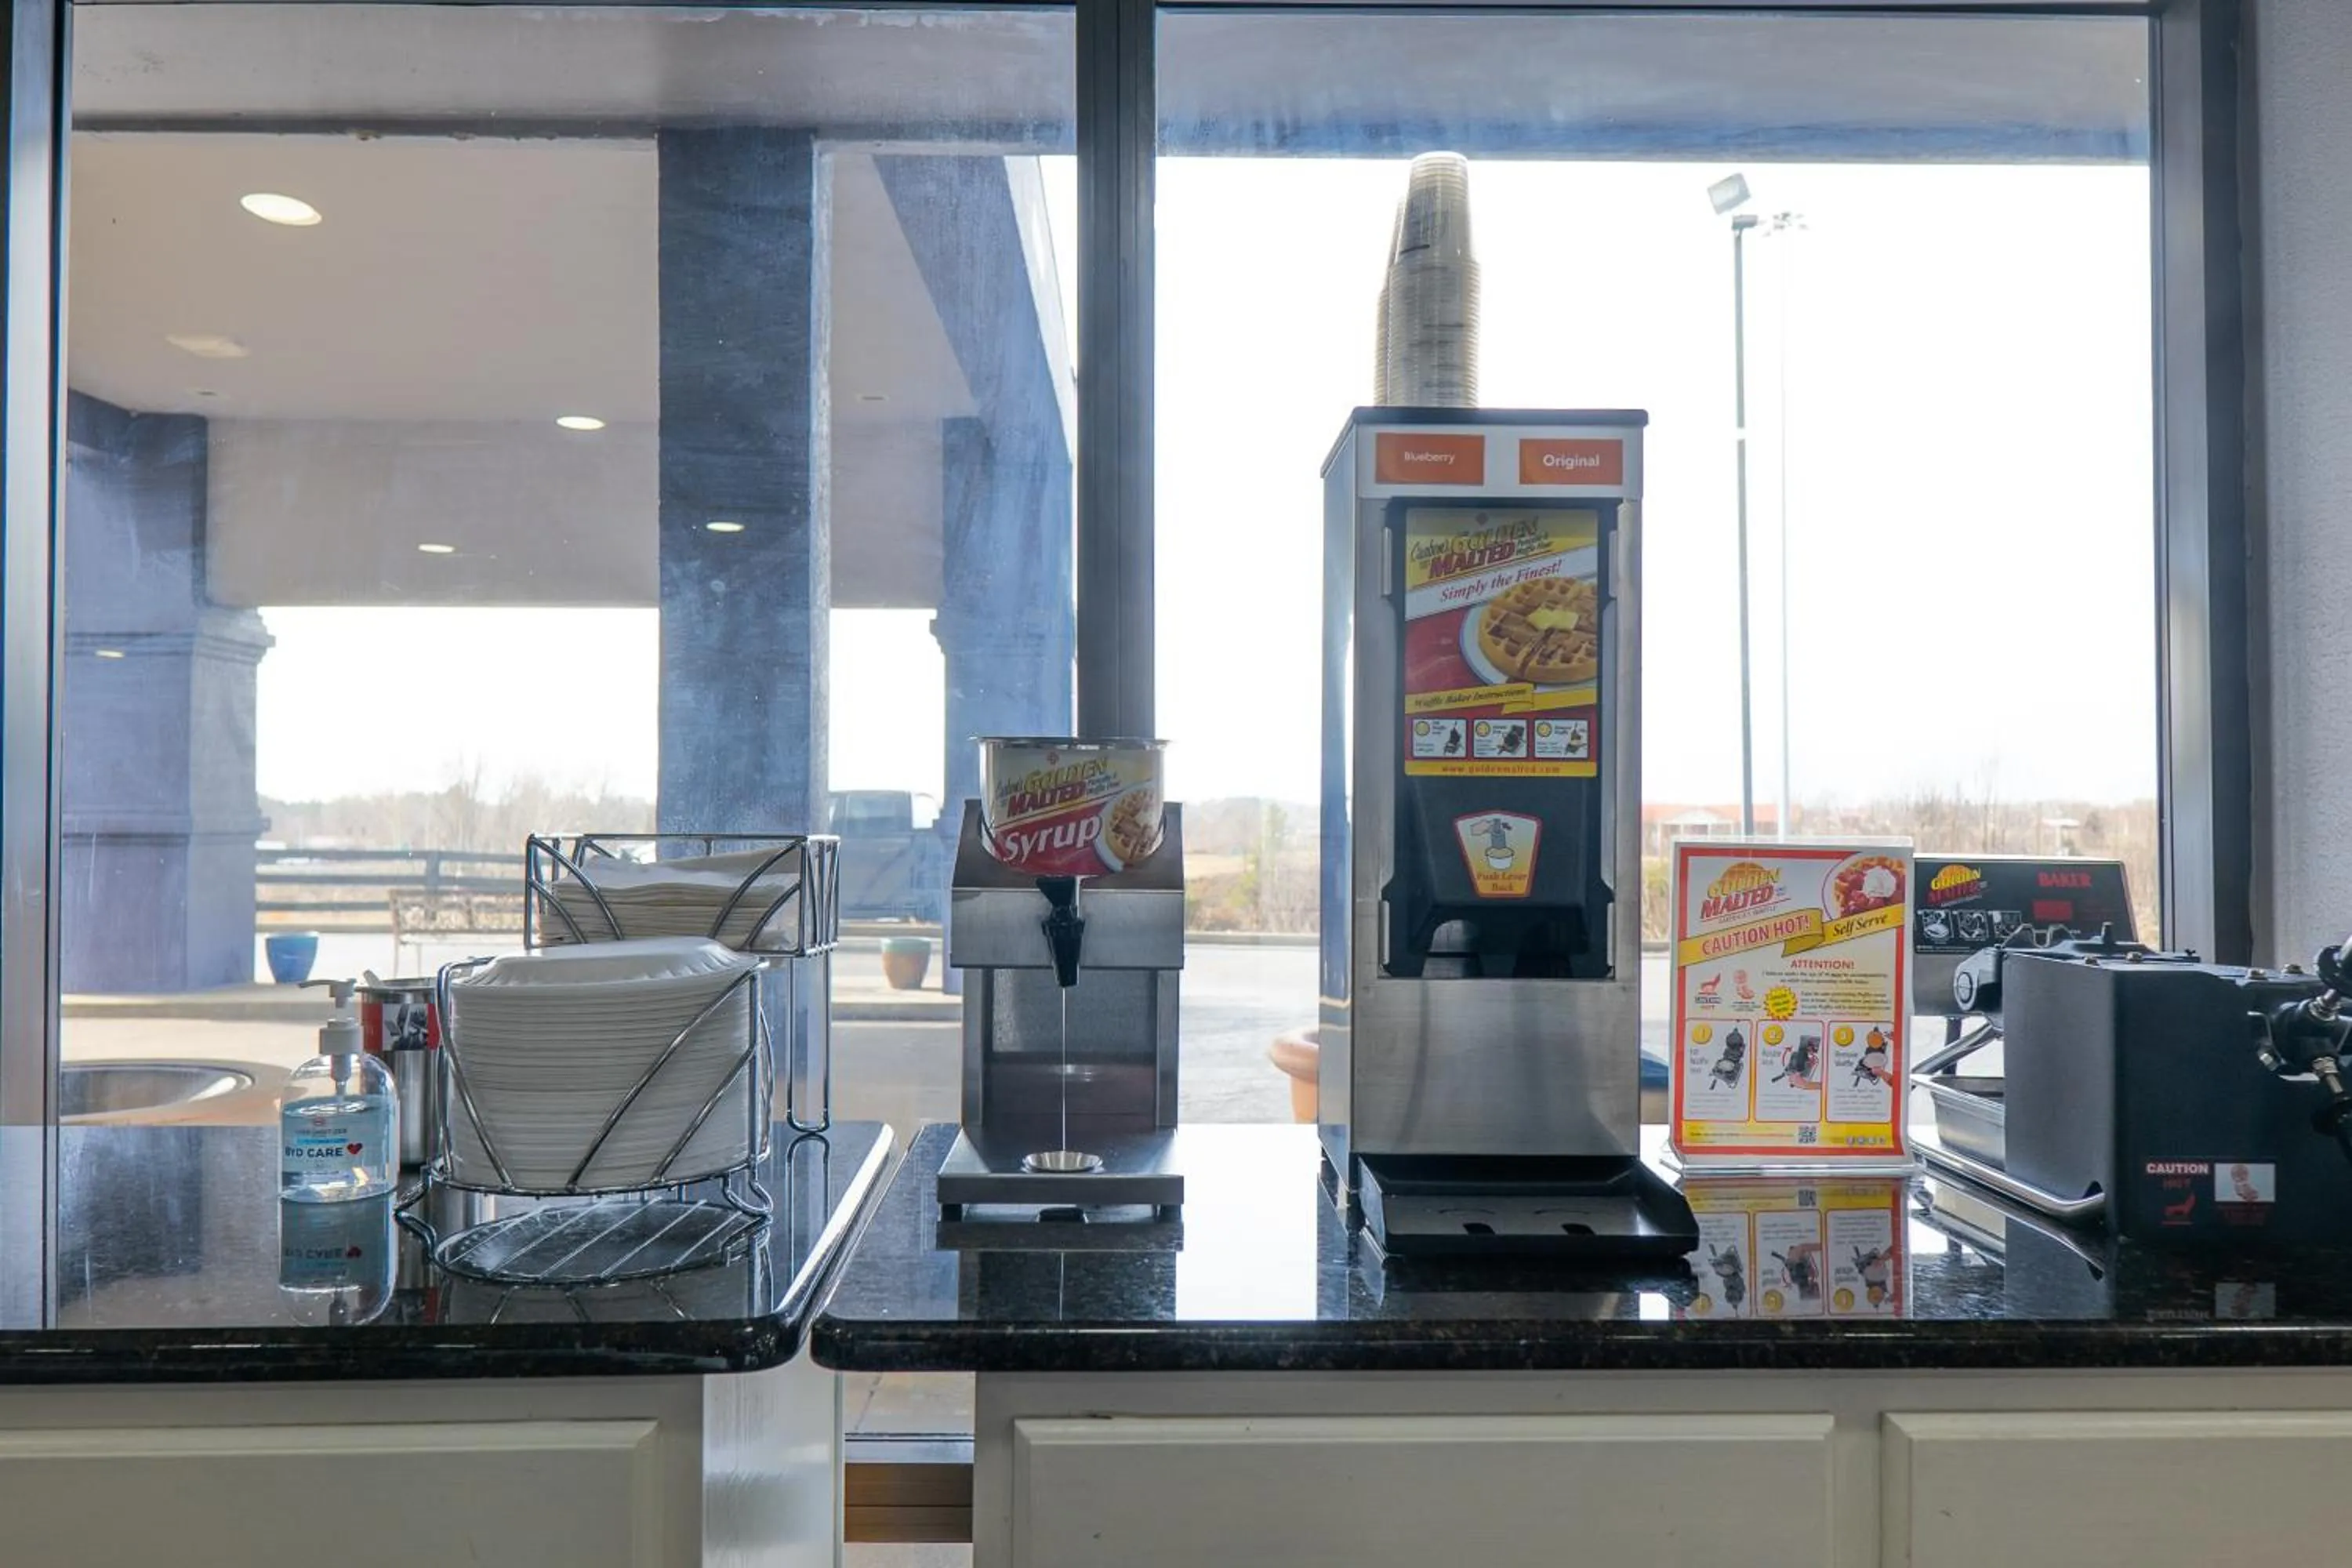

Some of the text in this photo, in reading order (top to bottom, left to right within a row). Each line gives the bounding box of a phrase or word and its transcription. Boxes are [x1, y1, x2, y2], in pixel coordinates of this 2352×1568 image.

[1404, 451, 1455, 464] Blueberry
[1542, 453, 1600, 470] Original
[1428, 541, 1515, 579] MALTED
[1440, 559, 1562, 602] Simply the Finest!
[1025, 757, 1109, 793] GOLDEN
[1007, 780, 1087, 818] MALTED
[1707, 866, 1781, 898] GOLDEN
[1931, 866, 1982, 891] GOLDEN
[2039, 871, 2092, 887] BAKER
[1700, 884, 1774, 920] MALTED
[1702, 915, 1810, 956] CAUTION HOT!
[1833, 913, 1888, 936] Self Serve
[1791, 959, 1855, 970] ATTENTION!
[285, 1145, 344, 1158] BYD CARE
[2146, 1163, 2209, 1174] CAUTION
